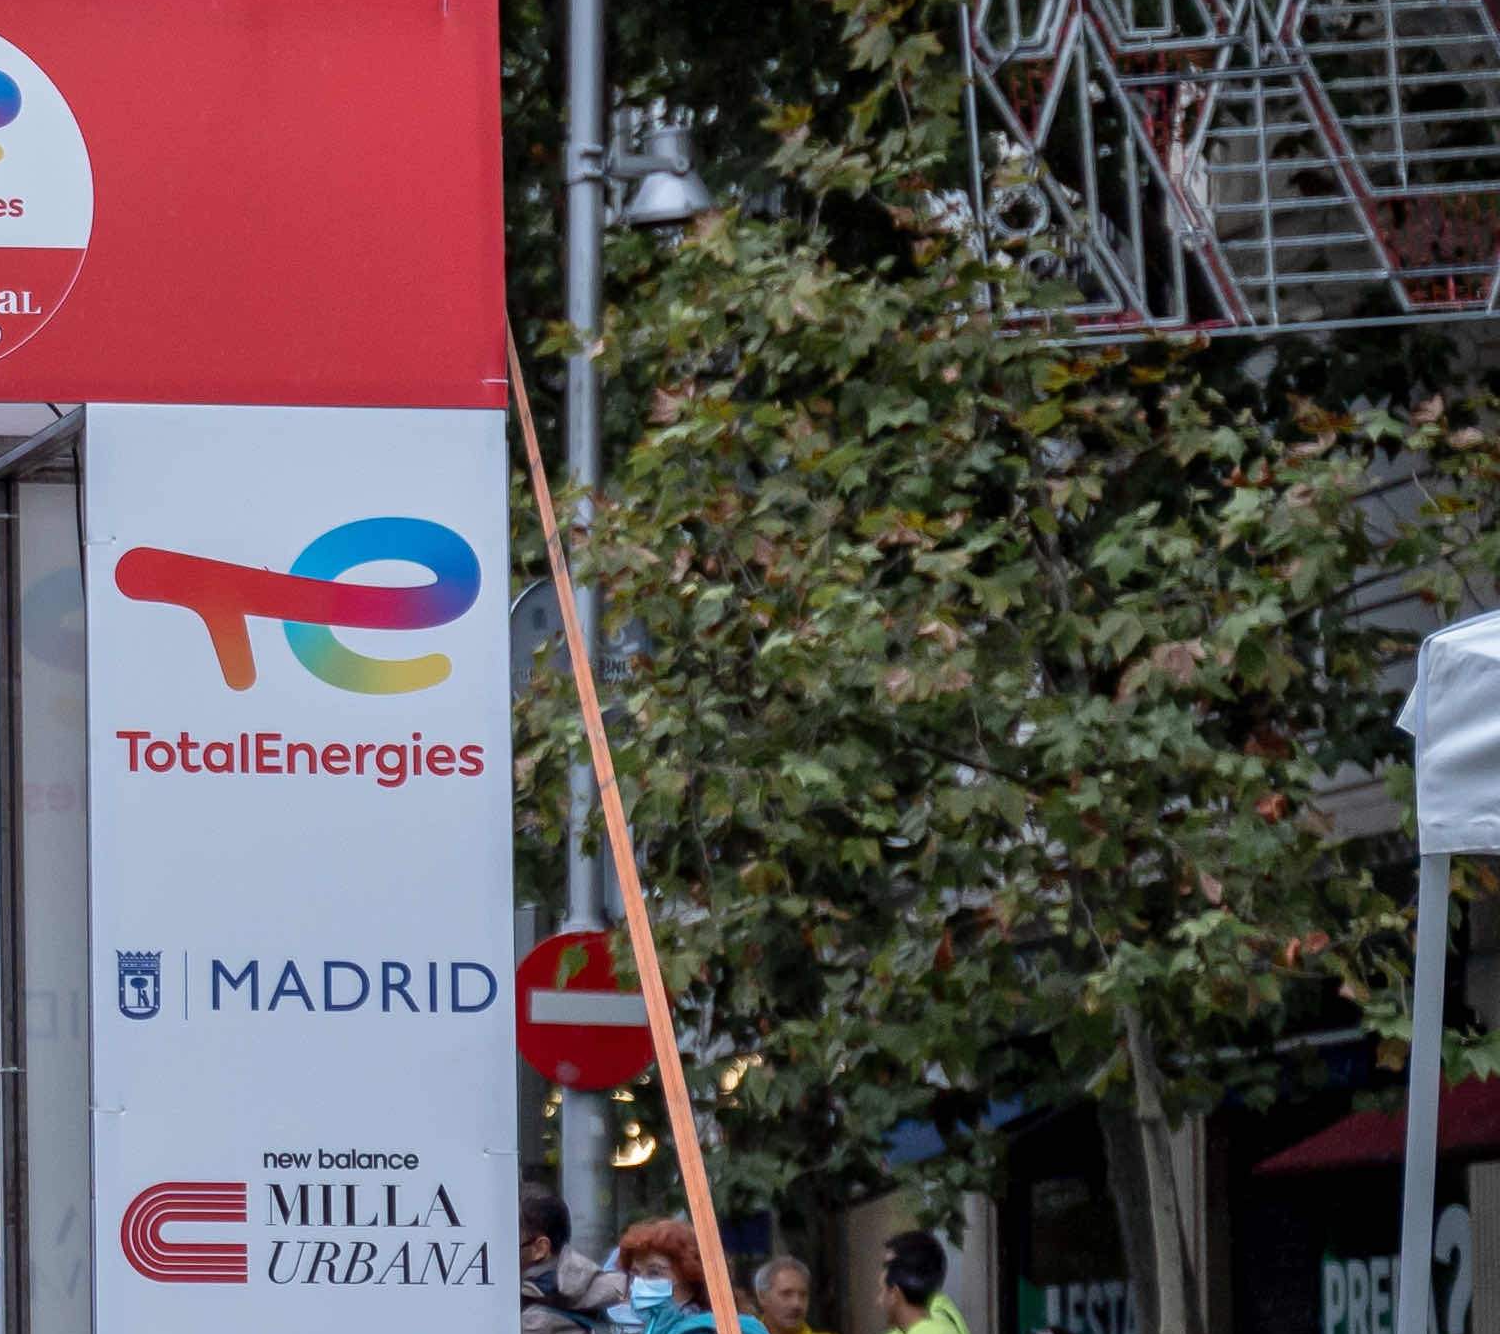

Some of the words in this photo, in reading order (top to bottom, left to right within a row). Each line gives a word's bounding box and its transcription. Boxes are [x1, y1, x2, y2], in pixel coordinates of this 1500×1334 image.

[116, 730, 485, 789] TotalEnergies
[211, 958, 499, 1014] MADRID
[263, 1151, 312, 1169] new
[318, 1148, 419, 1171] balance
[266, 1182, 467, 1228] MILLA
[267, 1240, 495, 1286] URBANA
